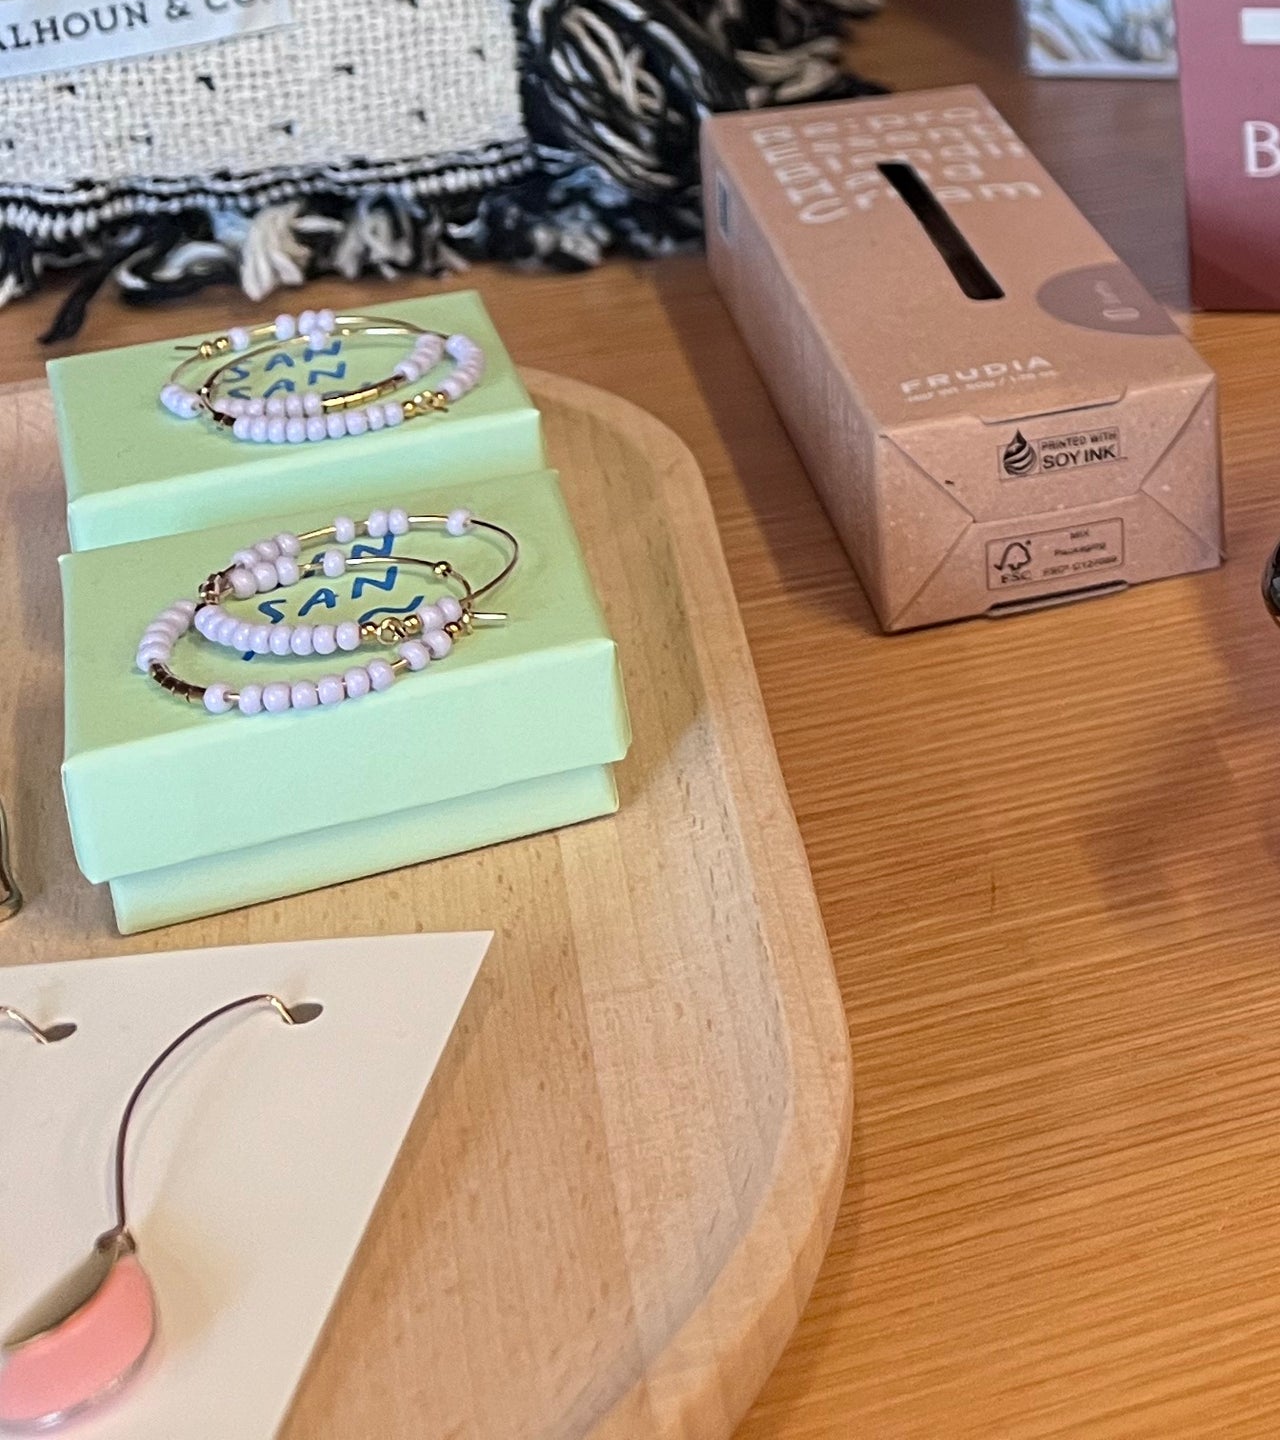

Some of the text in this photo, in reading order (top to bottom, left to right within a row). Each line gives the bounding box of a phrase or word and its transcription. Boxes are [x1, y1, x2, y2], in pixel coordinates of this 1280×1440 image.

[900, 356, 1053, 395] FRUDIA
[1041, 431, 1117, 451] PRINTED WITH
[1042, 443, 1116, 470] SOY INK
